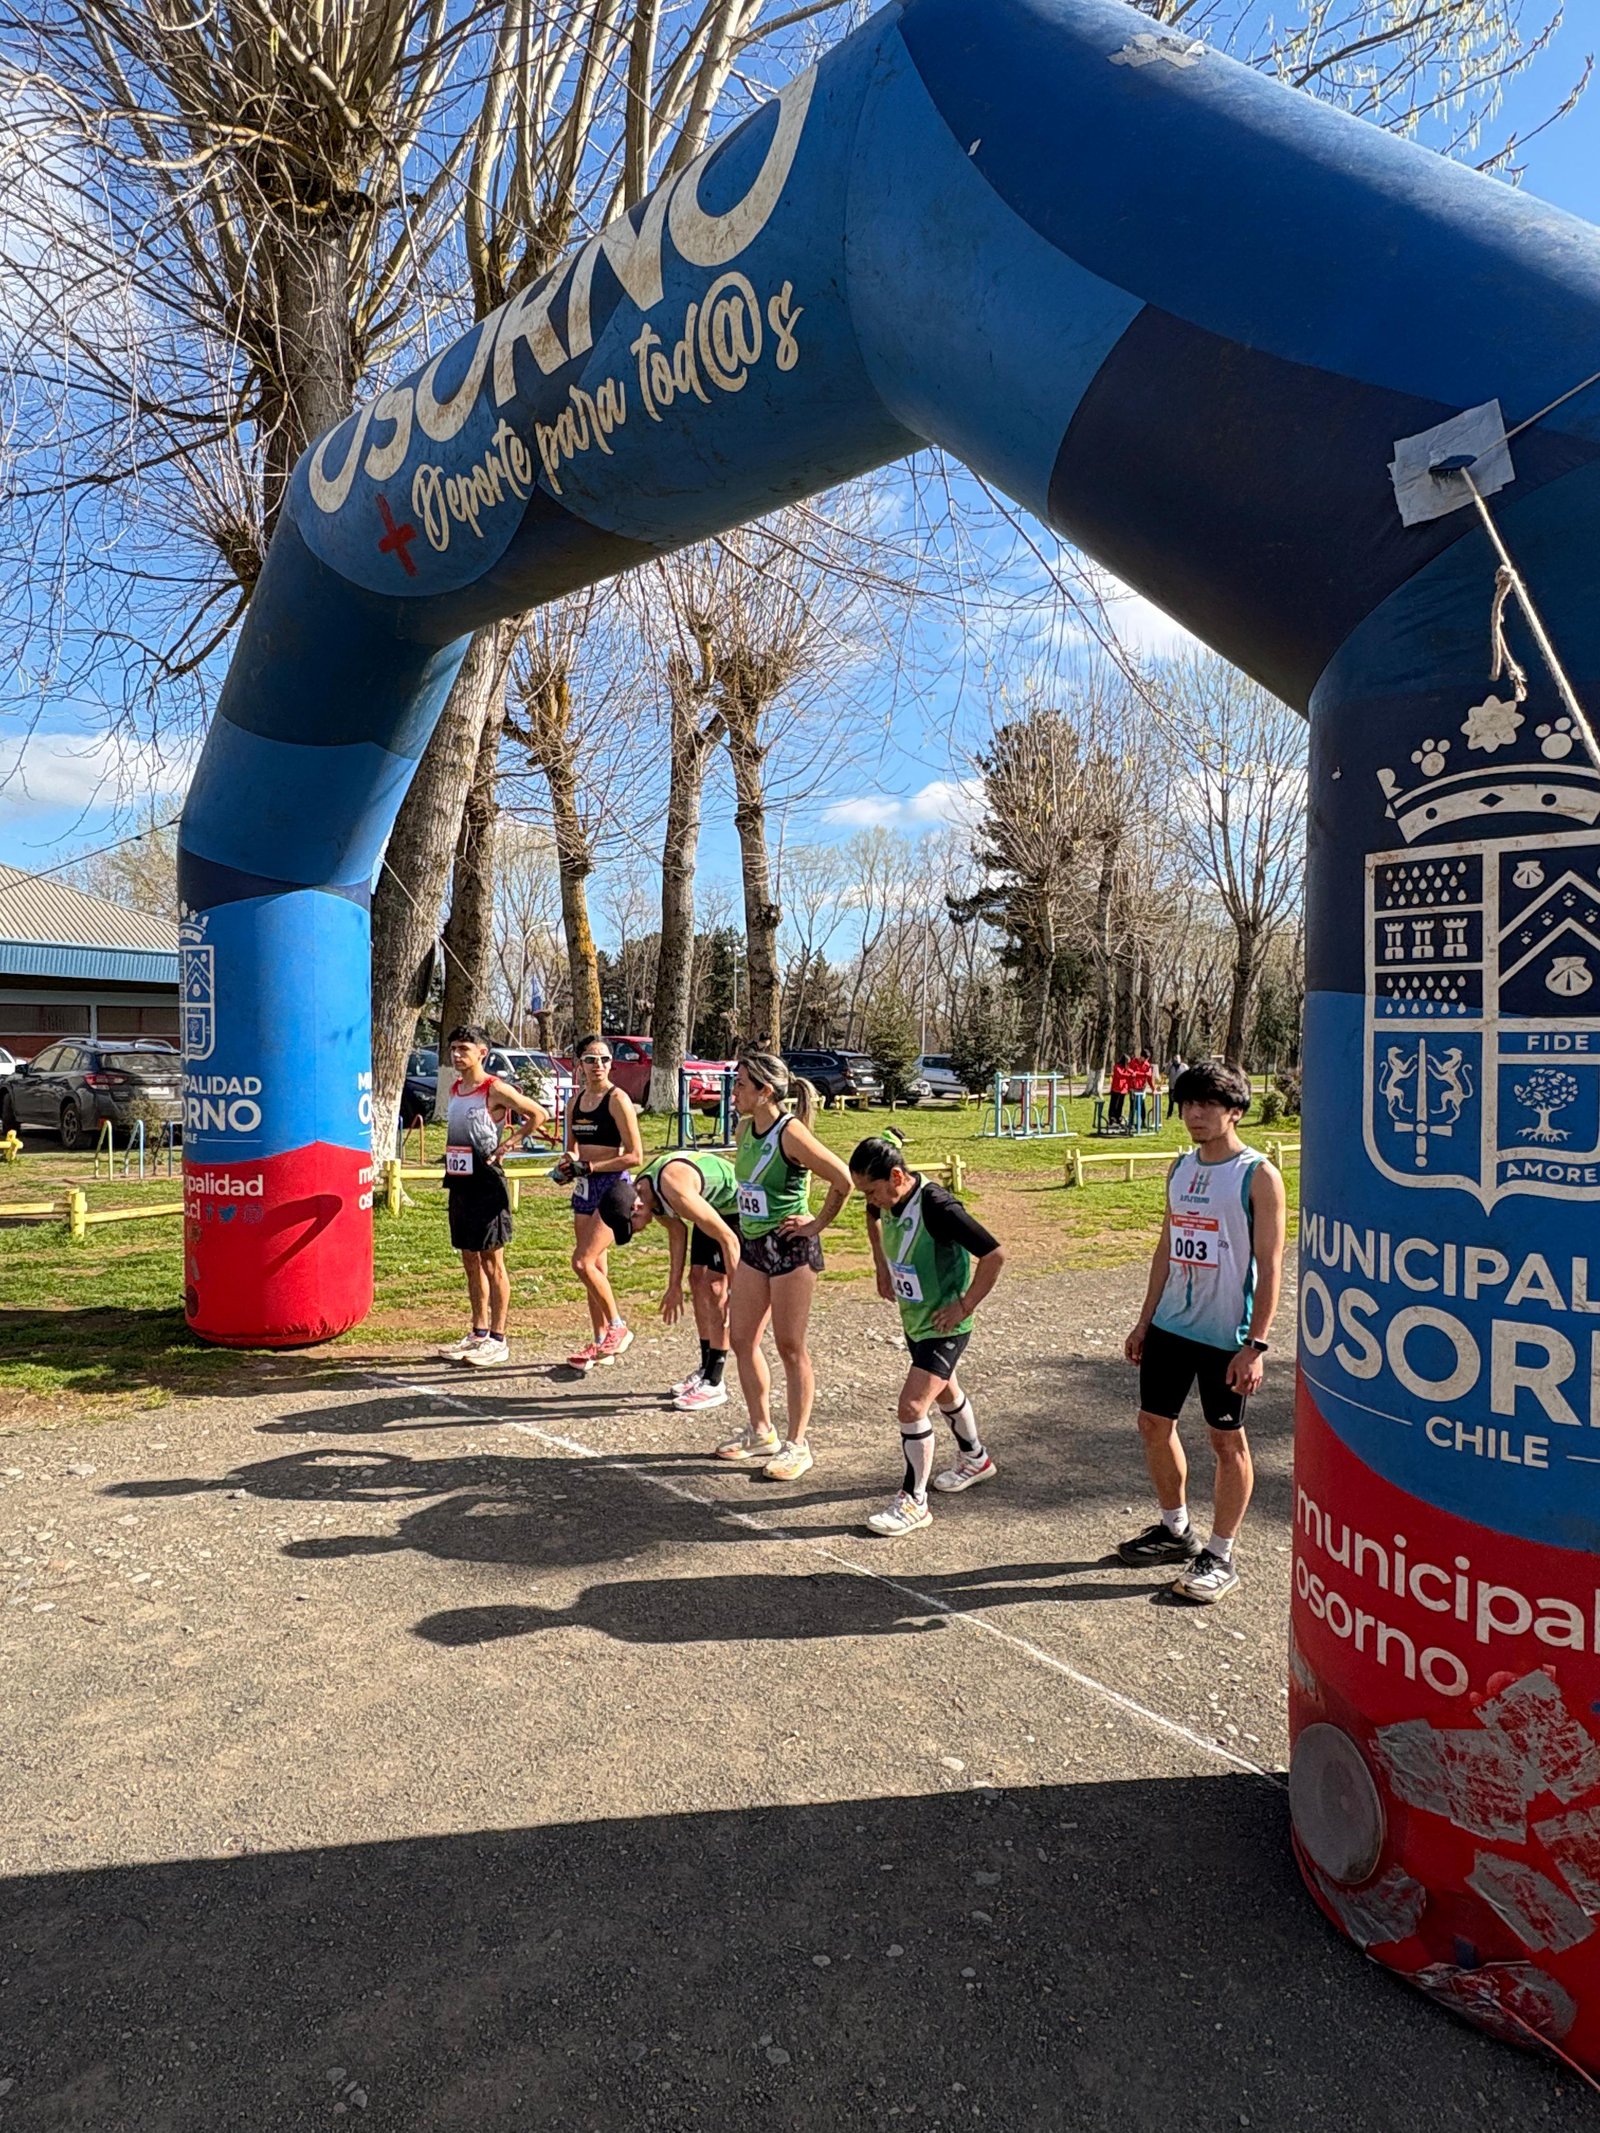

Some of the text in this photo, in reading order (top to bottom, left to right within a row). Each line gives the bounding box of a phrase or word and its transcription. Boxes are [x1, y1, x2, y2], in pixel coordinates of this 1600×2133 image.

[412, 418, 532, 551] Deporte
[534, 376, 627, 495] para
[629, 271, 805, 422] tod@s
[1527, 1034, 1590, 1051] FIDE
[1506, 1161, 1599, 1184] AMORE
[1176, 1238, 1207, 1260] 003
[1425, 1416, 1550, 1470] CHILE
[1296, 1556, 1469, 1697] osorno
